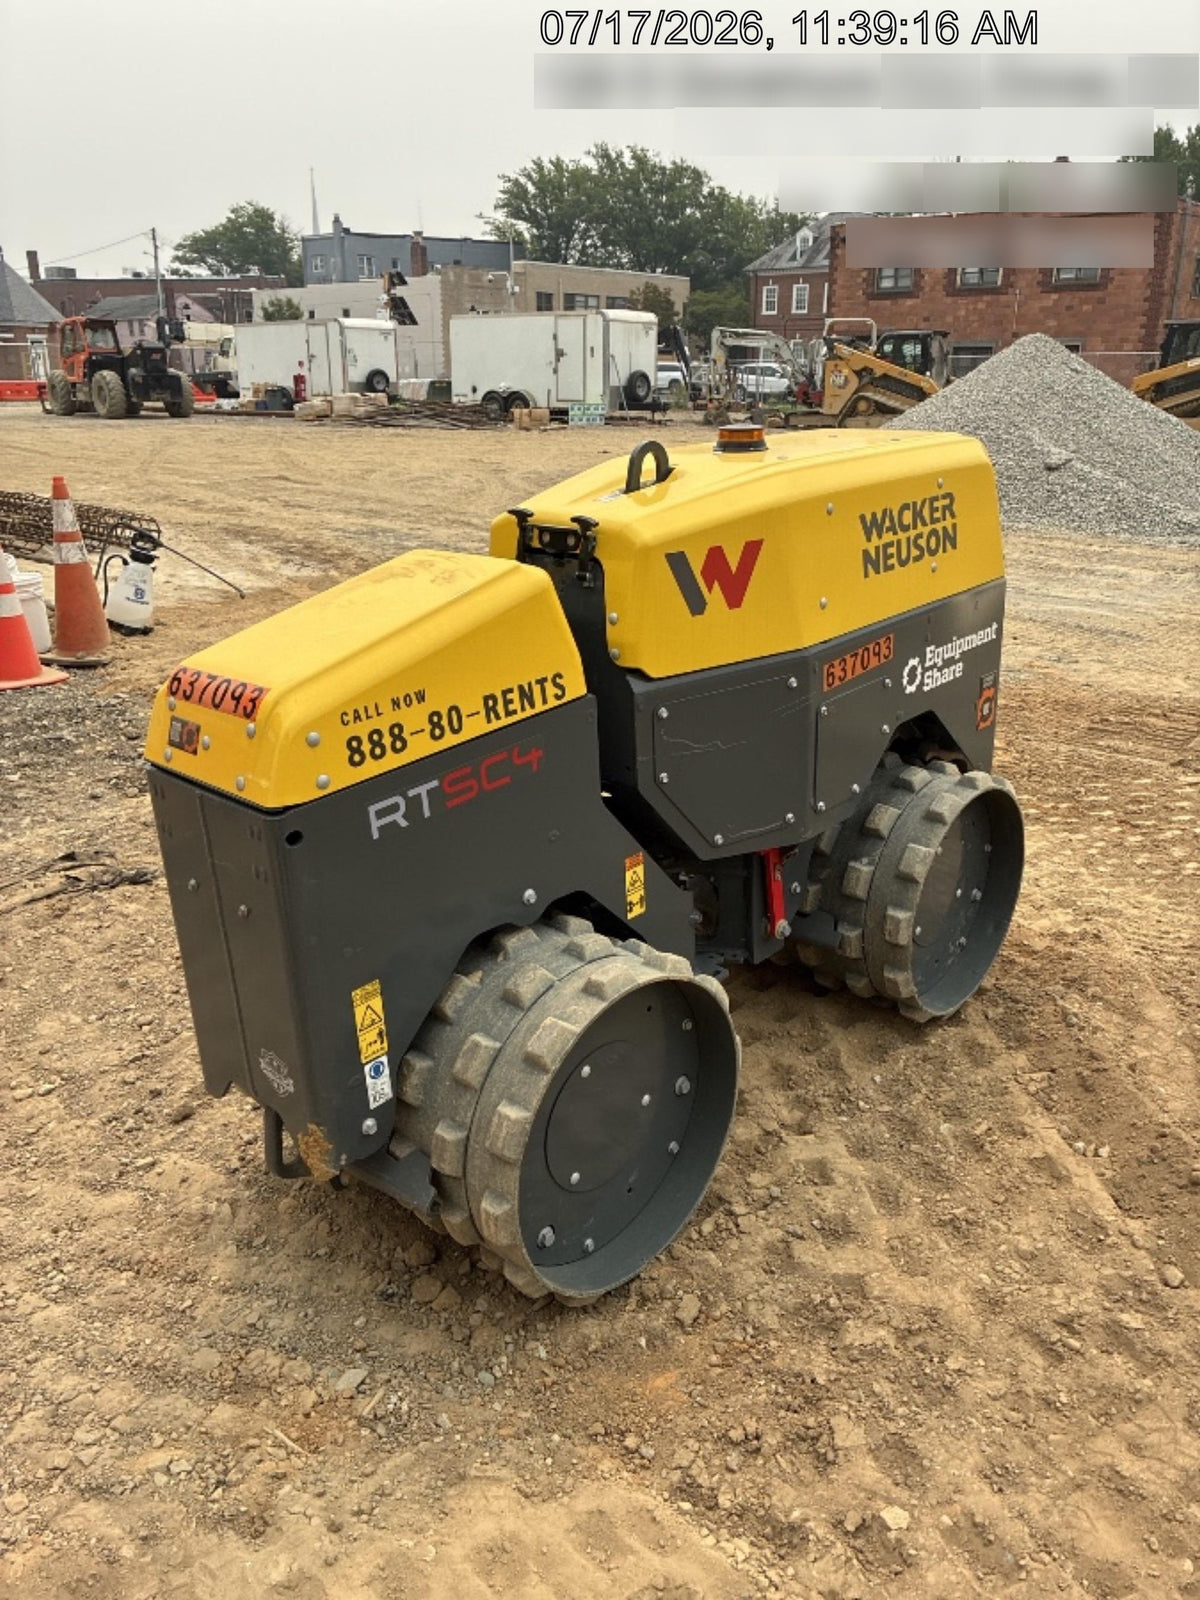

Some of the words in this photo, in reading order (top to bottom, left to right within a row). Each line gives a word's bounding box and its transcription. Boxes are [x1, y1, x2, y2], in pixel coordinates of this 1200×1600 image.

[859, 492, 957, 543] WACKER
[862, 523, 958, 578] NEUSON
[826, 636, 893, 688] 637093
[924, 621, 999, 668] Equipment
[169, 667, 263, 719] 637093
[922, 661, 964, 692] Share
[340, 704, 384, 727] CALL
[391, 688, 427, 712] NOW
[345, 672, 567, 769] 888-80-RENTS
[367, 746, 544, 840] RTSC4
